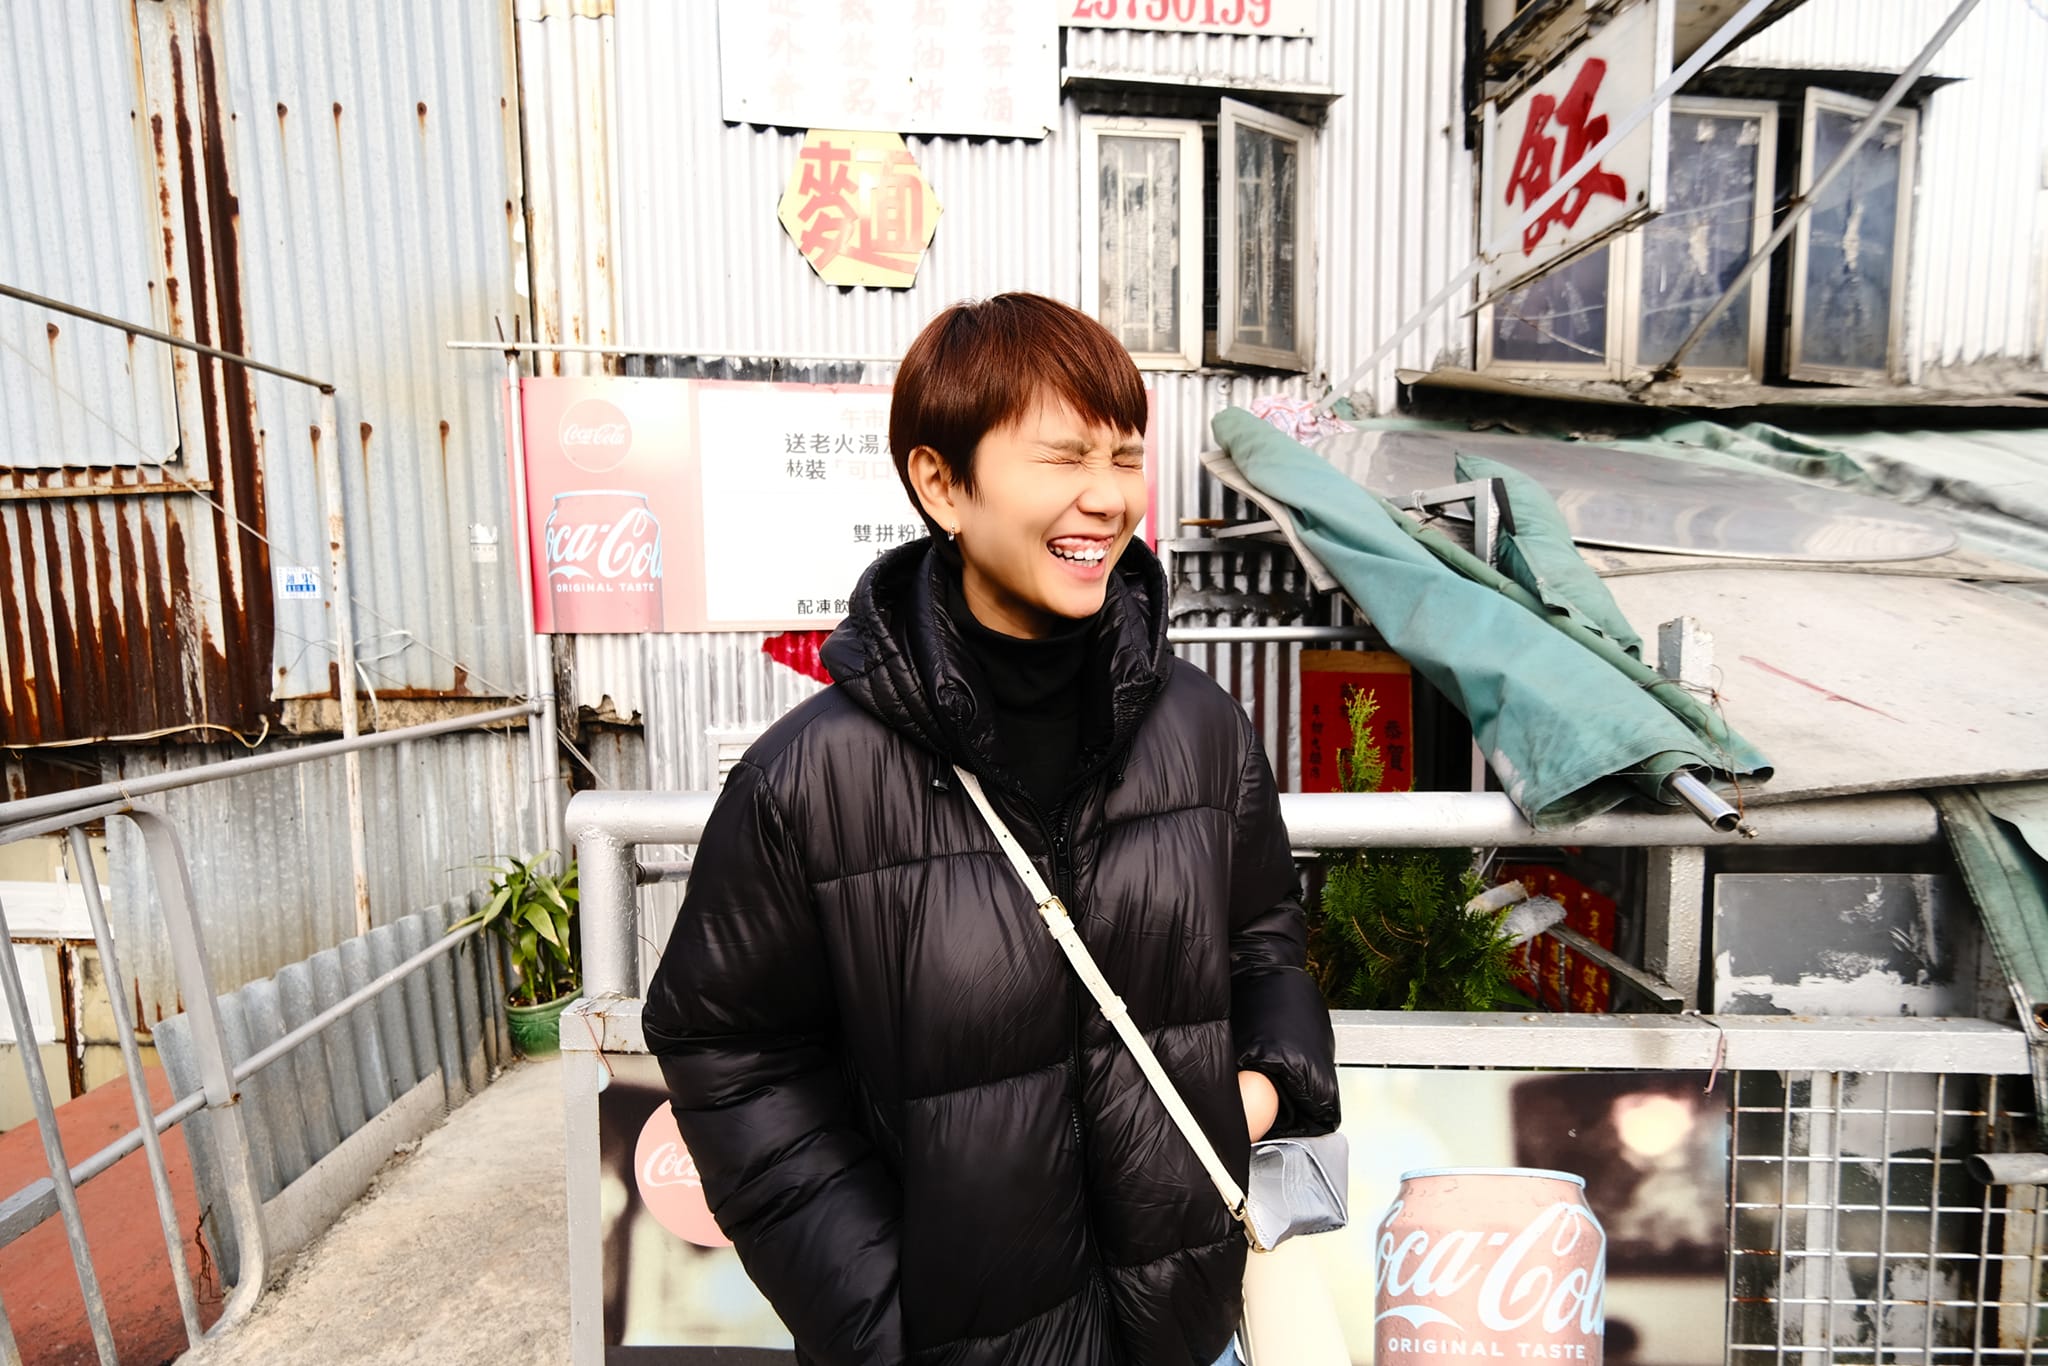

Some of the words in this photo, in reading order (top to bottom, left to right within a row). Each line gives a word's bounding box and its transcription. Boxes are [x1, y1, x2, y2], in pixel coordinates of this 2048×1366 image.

[785, 433, 891, 455] 送老火湯
[556, 583, 614, 593] ORIGINAL
[619, 583, 655, 593] TASTE
[1388, 1337, 1504, 1357] ORIGINAL
[1517, 1342, 1586, 1360] TASTE
